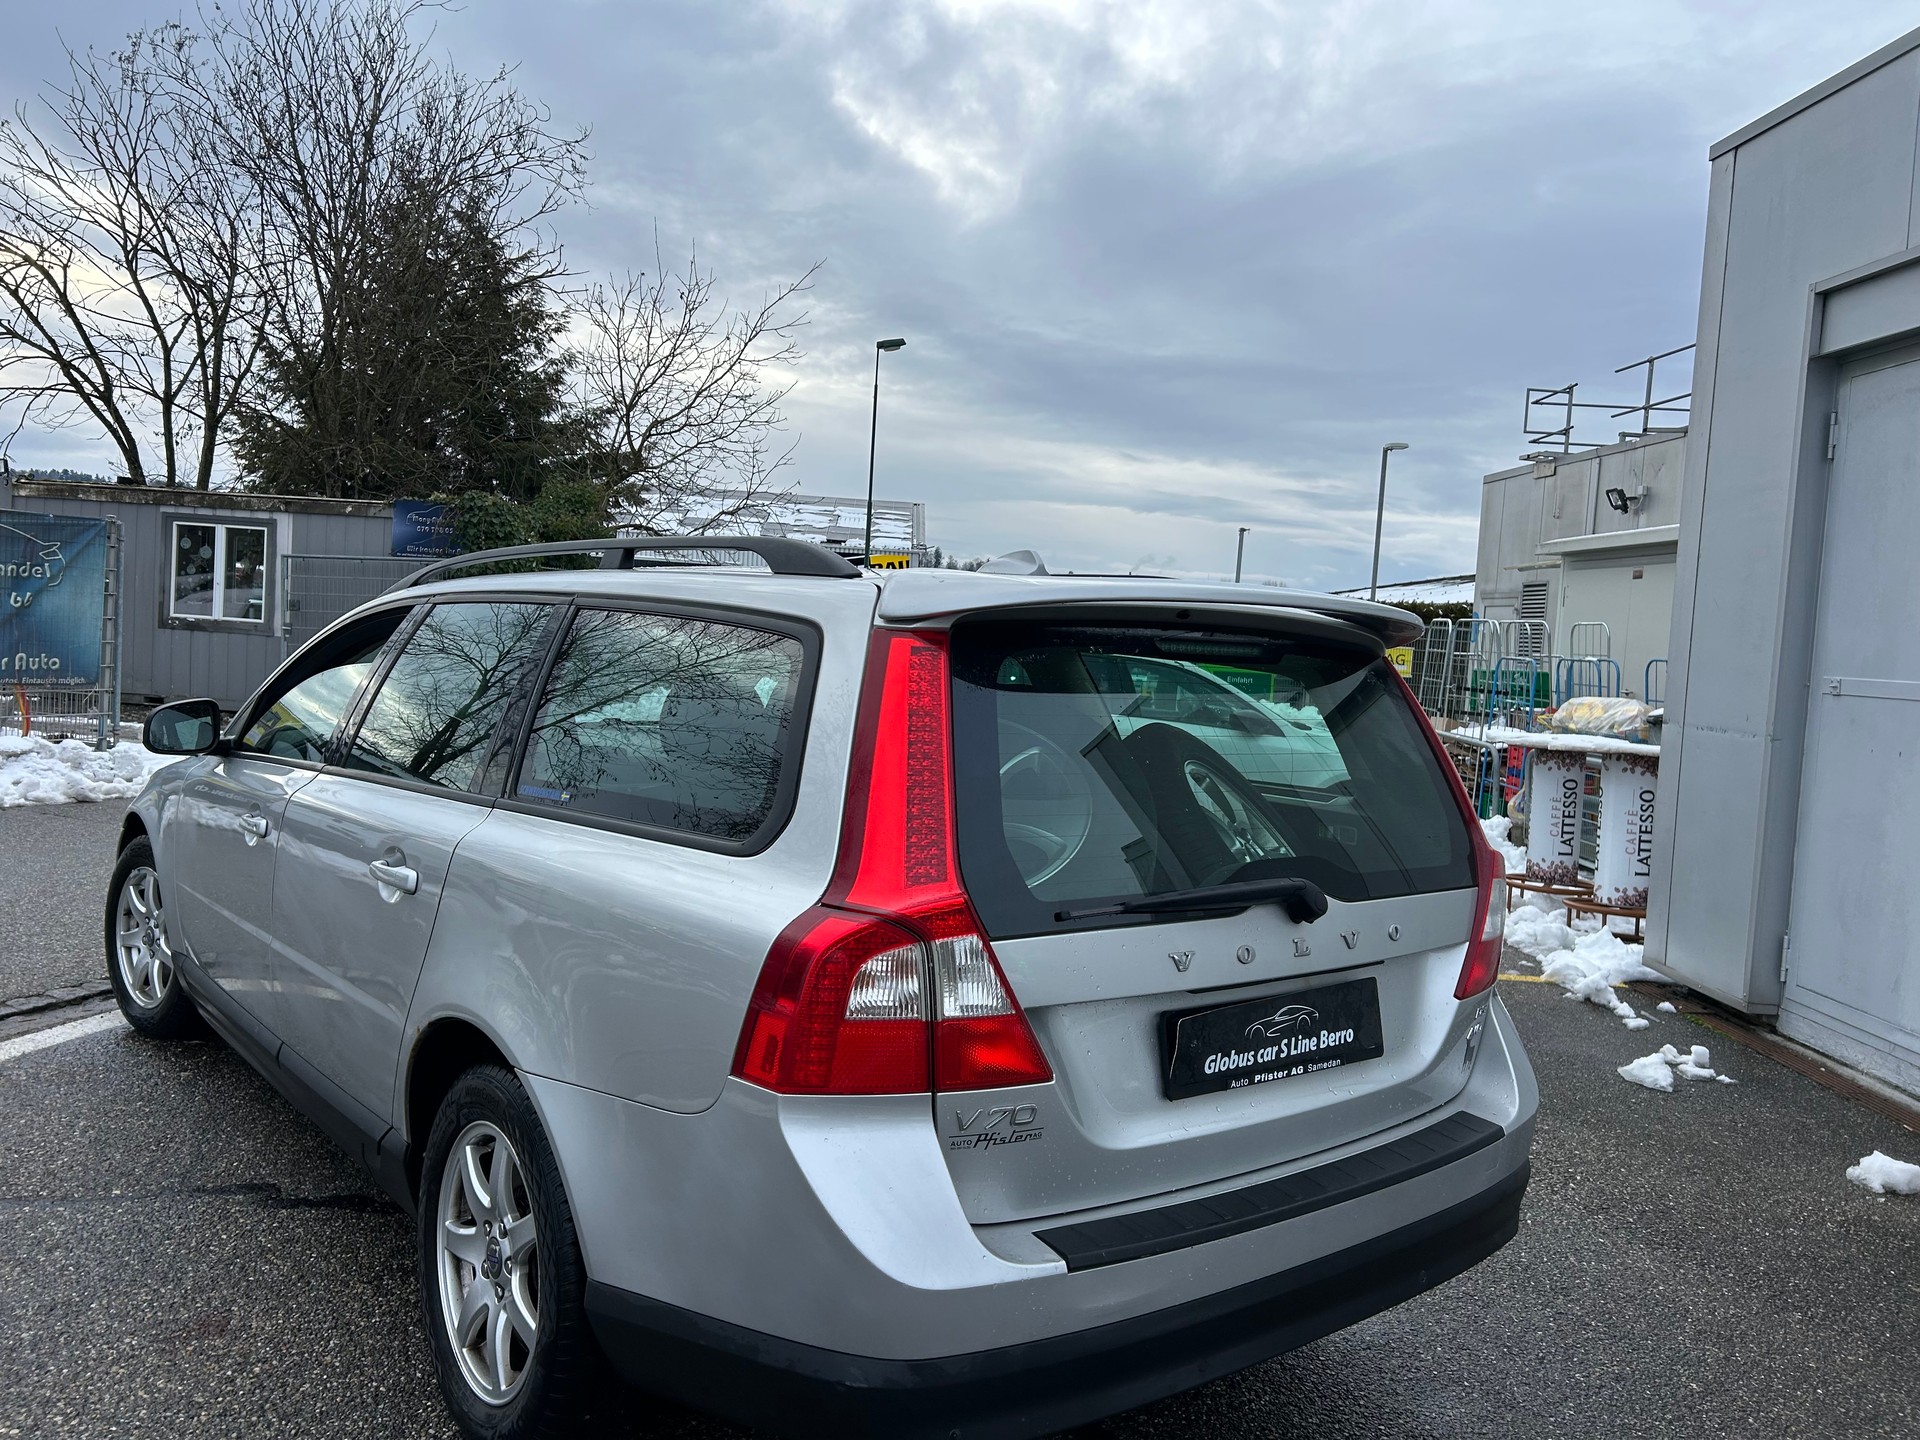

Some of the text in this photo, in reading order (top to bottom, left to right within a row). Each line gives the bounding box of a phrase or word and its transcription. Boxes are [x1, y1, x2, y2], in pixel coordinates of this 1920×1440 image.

[15, 653, 60, 670] Auto
[22, 676, 57, 684] Eintausch
[1227, 676, 1253, 684] Einfahrt
[1549, 796, 1562, 838] CAFFÈ
[1558, 779, 1578, 857] LATTESSO
[1624, 809, 1638, 855] CAFFÈ
[1635, 789, 1655, 877] LATTESSO
[1168, 923, 1401, 972] VOLVO
[1204, 1028, 1354, 1075] Globus car S Line Berro
[1230, 1059, 1341, 1088] Auto Pfister AG Samedan
[950, 1139, 973, 1147] AUTO
[973, 1129, 1033, 1150] Pfister
